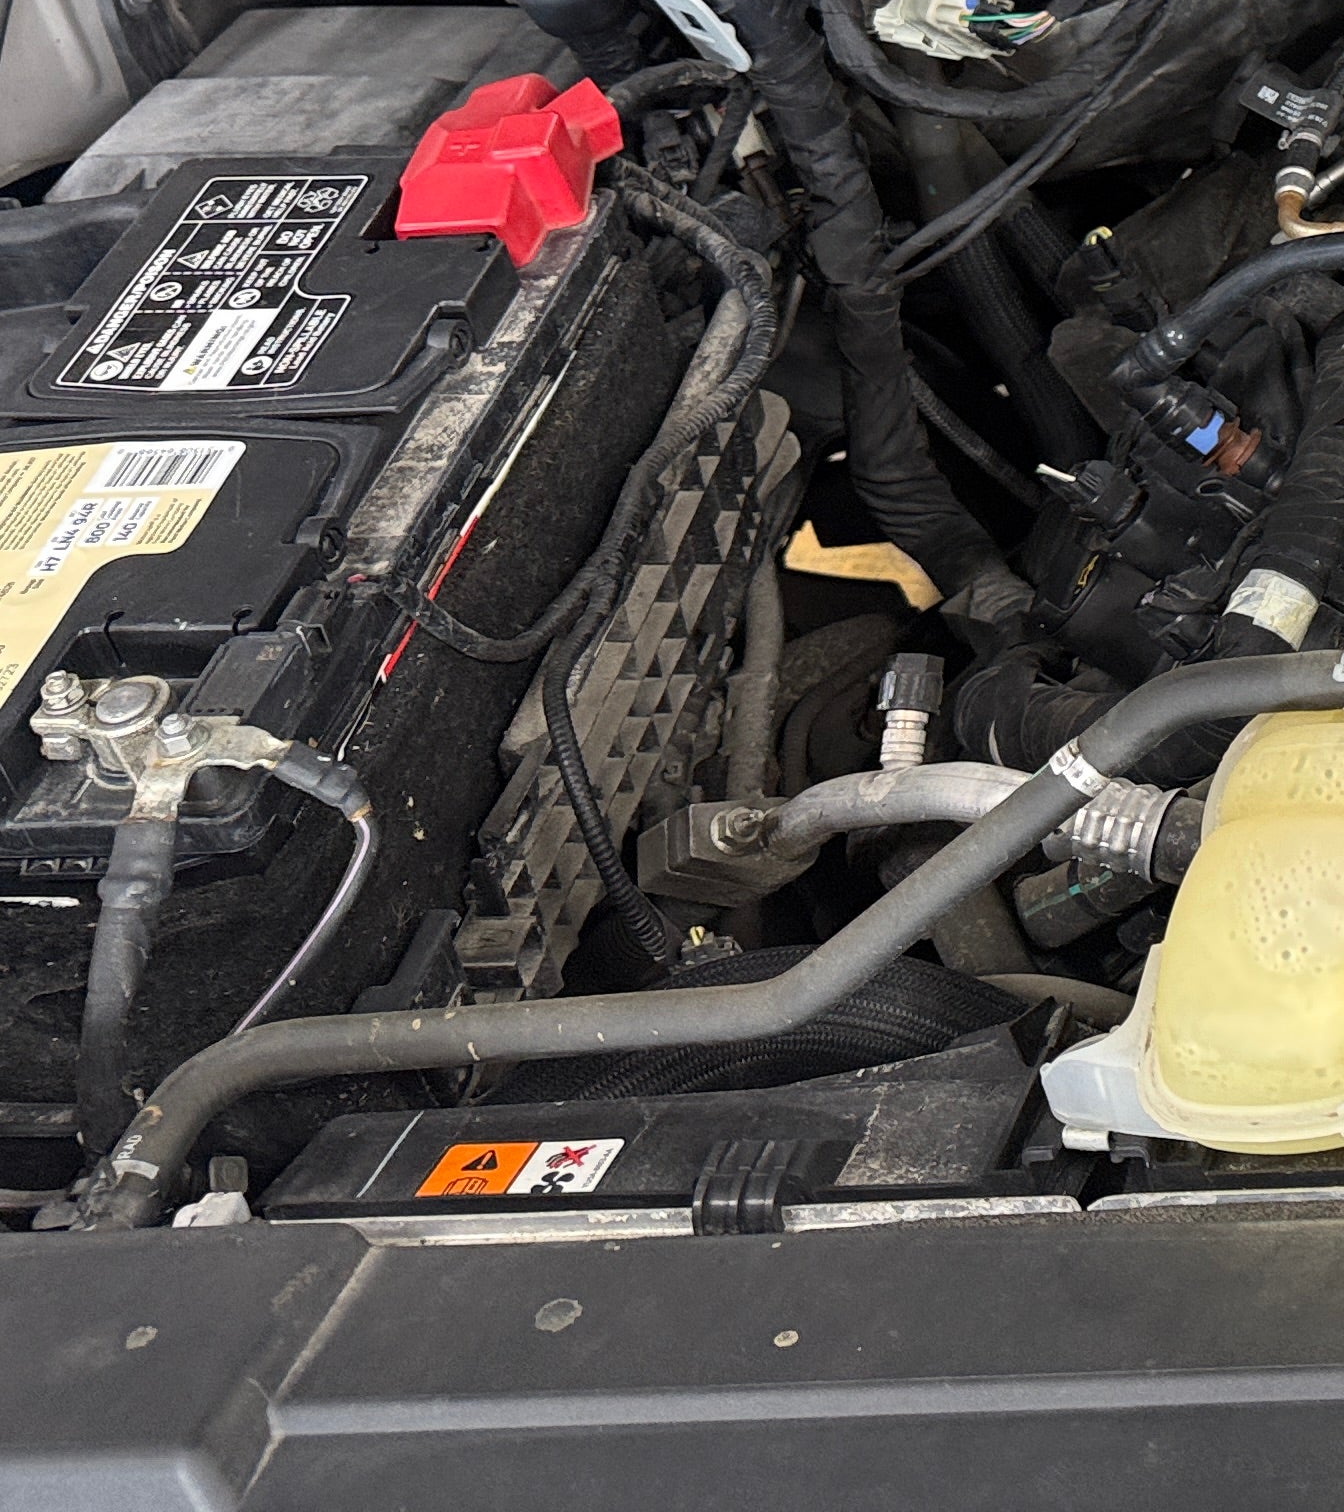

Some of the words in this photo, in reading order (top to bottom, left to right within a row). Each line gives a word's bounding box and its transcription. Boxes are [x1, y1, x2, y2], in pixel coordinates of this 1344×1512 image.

[94, 249, 176, 343] DANGER/POISON
[41, 556, 61, 572] H7
[53, 528, 79, 551] LN4
[75, 502, 98, 524] 94R
[85, 522, 110, 544] 800
[112, 522, 137, 542] 140
[117, 1135, 142, 1159] RAD
